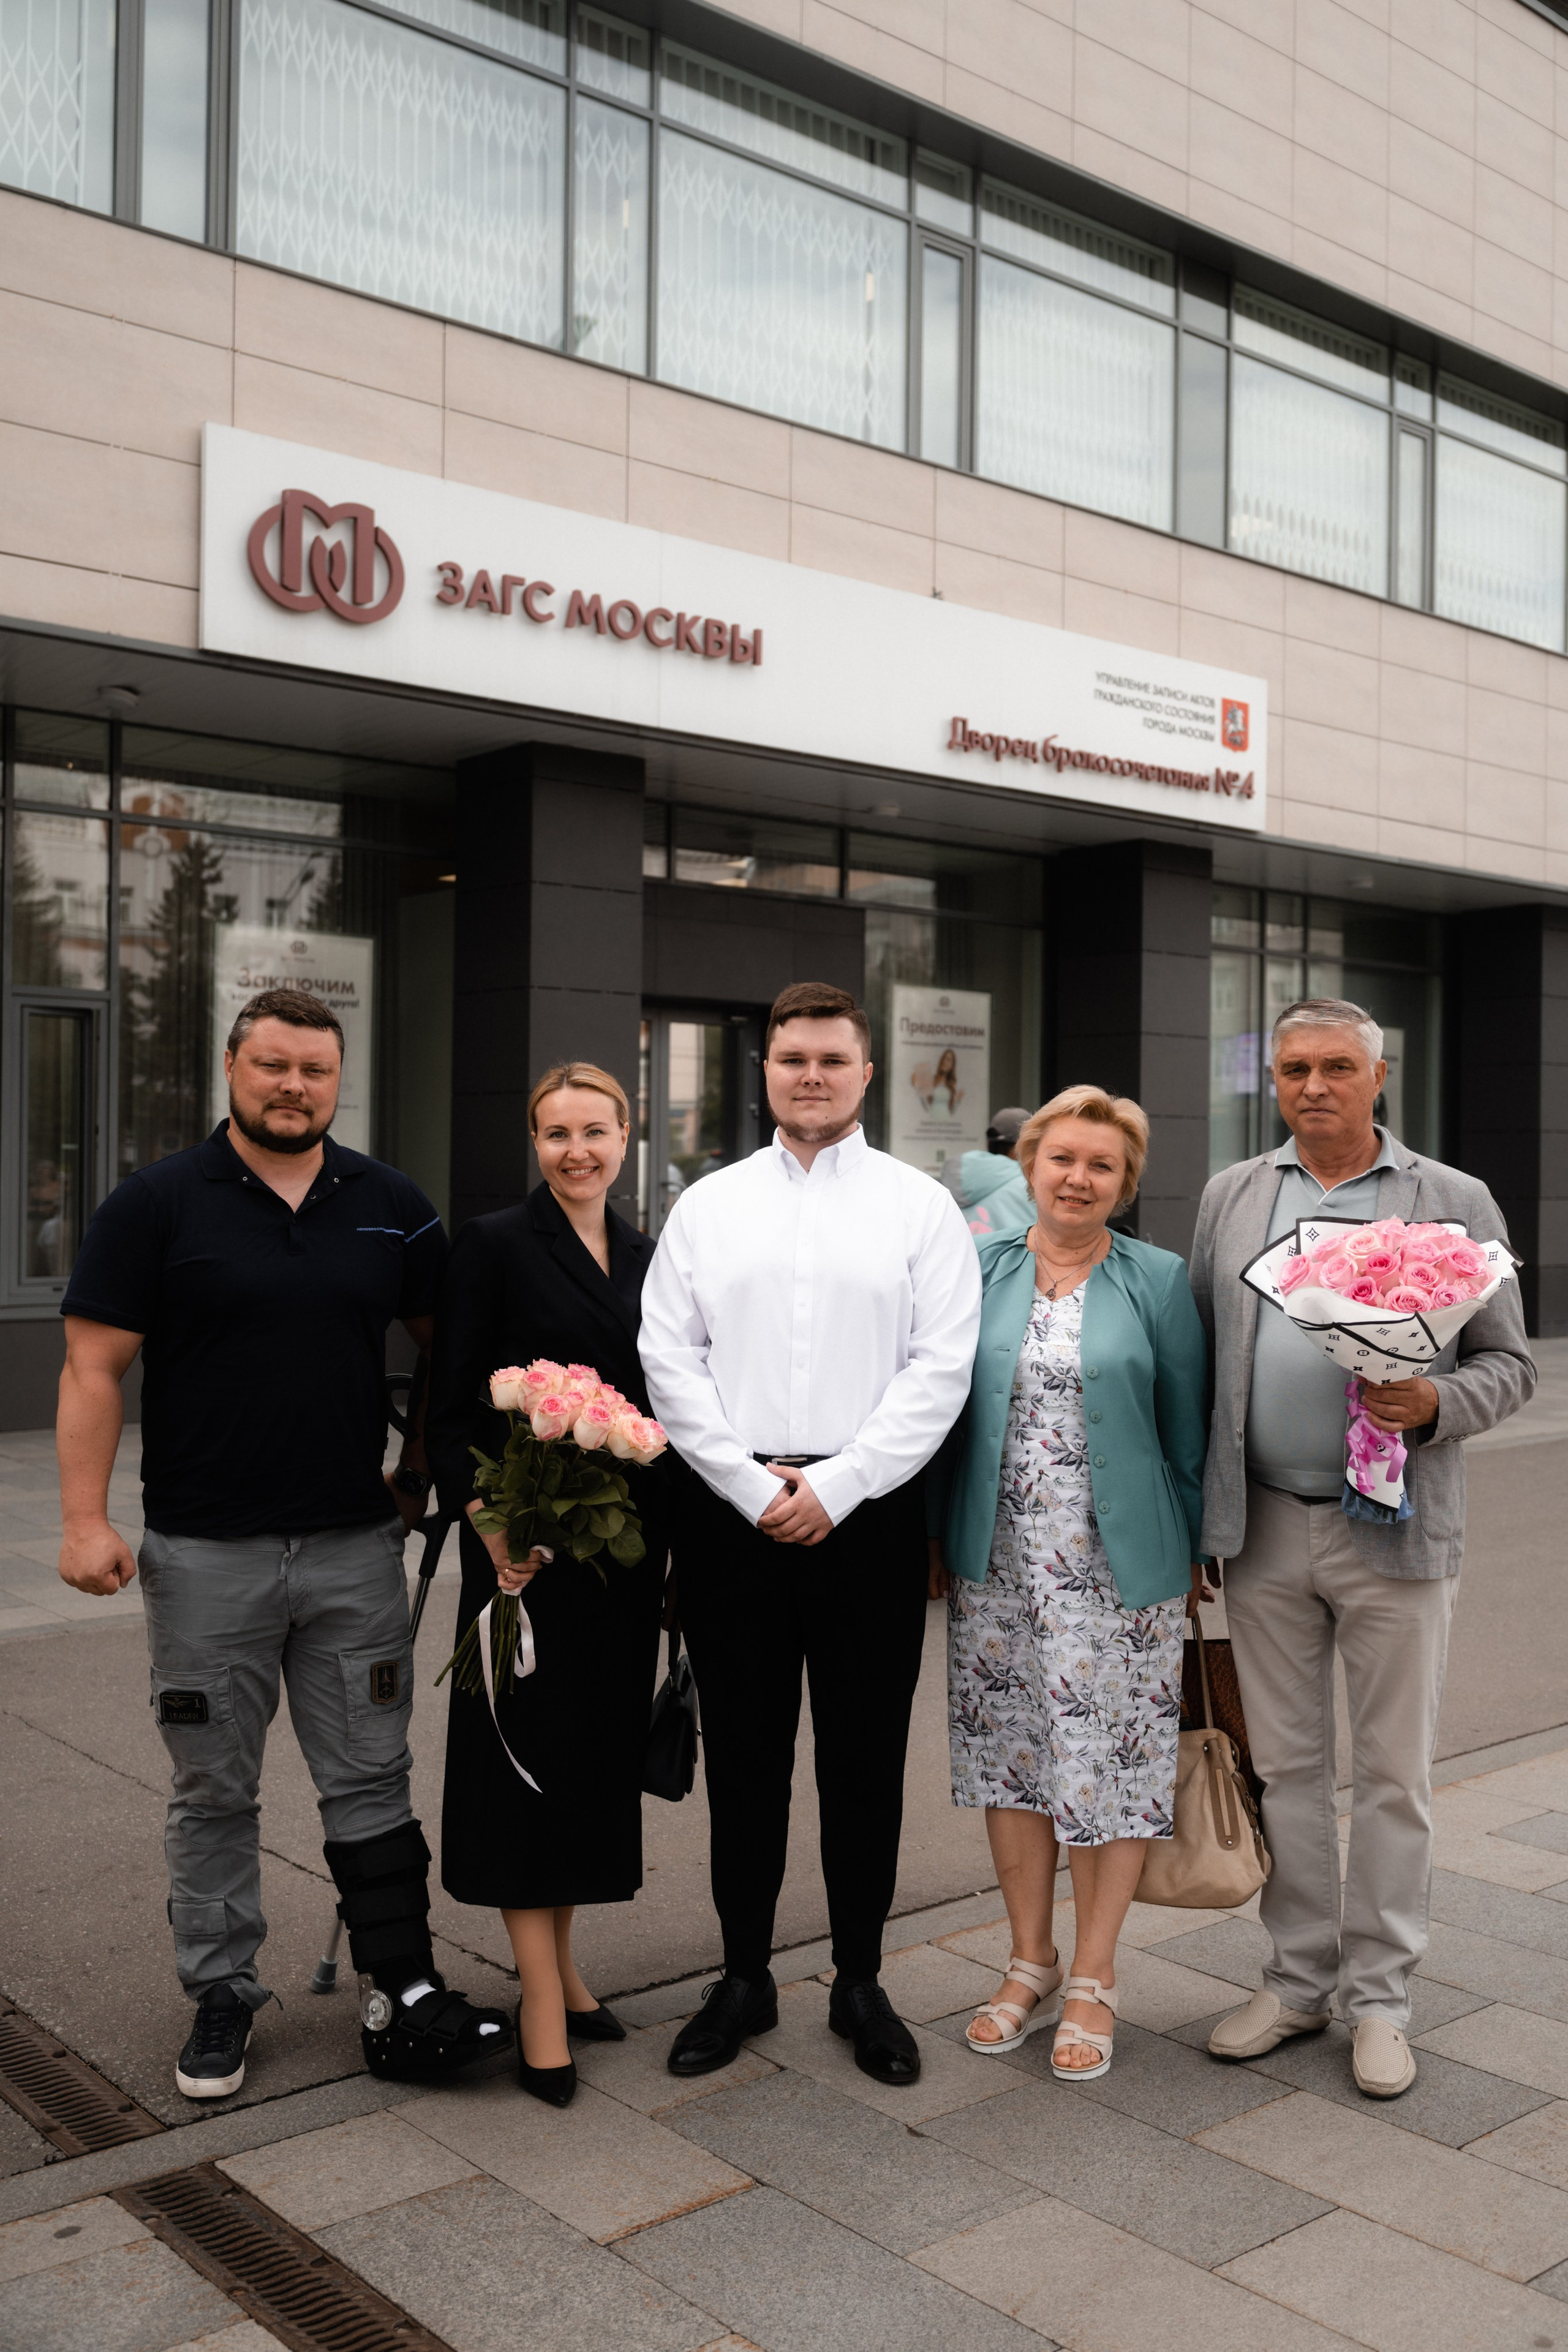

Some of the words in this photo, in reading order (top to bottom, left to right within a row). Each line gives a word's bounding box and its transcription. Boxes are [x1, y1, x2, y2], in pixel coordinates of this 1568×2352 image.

[436, 561, 556, 624] ЗАГС
[564, 589, 764, 666] МОСКВЫ
[1095, 671, 1151, 695] УПРАВЛЕНИЕ
[1152, 684, 1188, 703] ЗАПИСИ
[1093, 688, 1163, 714] ГРАЖДАНСКОГО
[1164, 704, 1215, 725] СОСТОЯНИЯ
[1142, 717, 1177, 735] ГОРОДА
[947, 716, 1038, 763] Дворец
[1042, 734, 1210, 791] бракосочетания
[236, 966, 355, 995] Заключим
[899, 1016, 986, 1038] Предоставим
